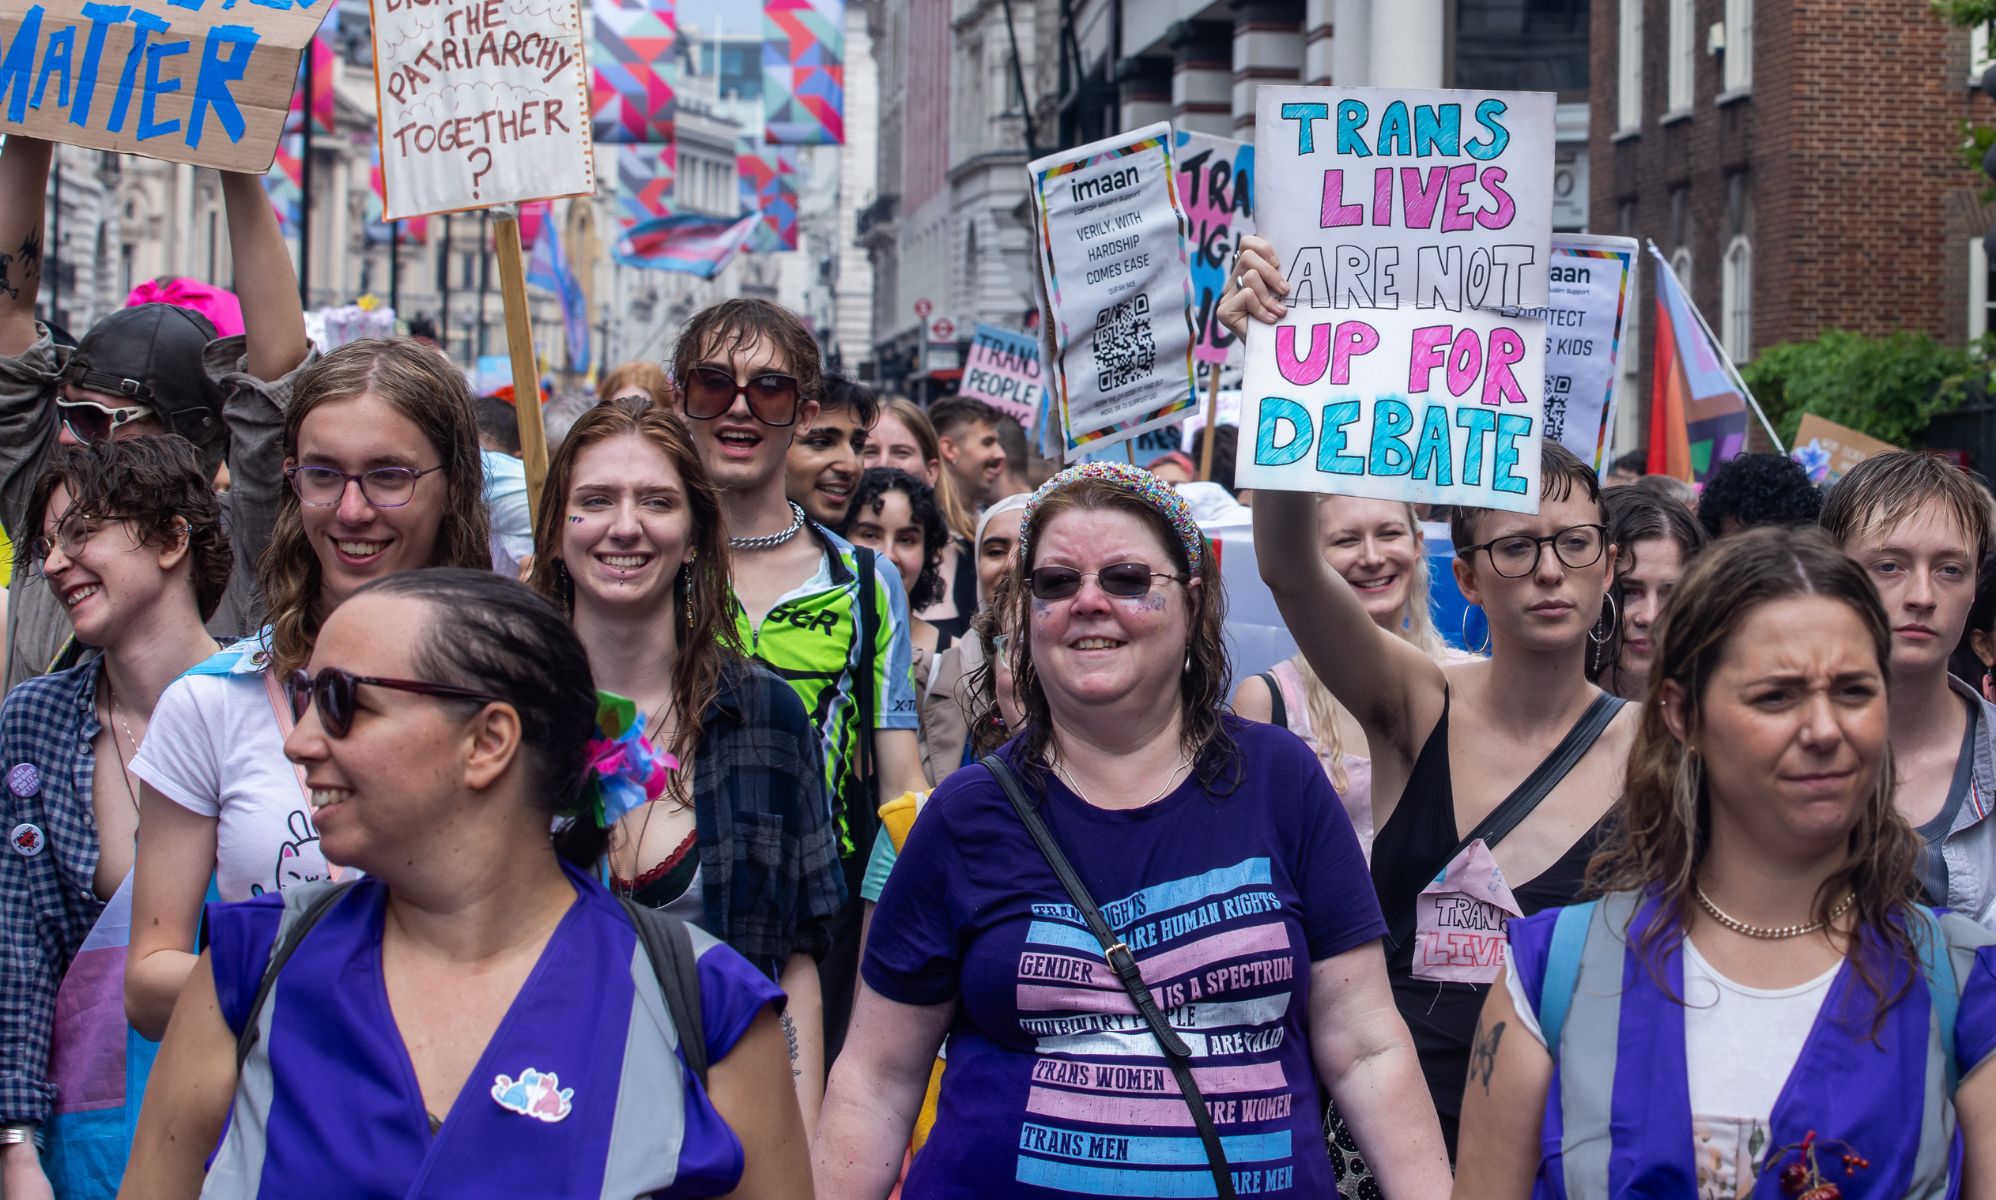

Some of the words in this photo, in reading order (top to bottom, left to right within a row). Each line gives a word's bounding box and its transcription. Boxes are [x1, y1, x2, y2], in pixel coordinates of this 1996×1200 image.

[444, 0, 507, 36] THE
[387, 31, 572, 104] PATRIARCHY
[393, 99, 570, 157] TOGETHER
[1281, 98, 1510, 160] TRANS
[467, 147, 492, 200] ?
[1071, 166, 1140, 203] imaan
[1320, 163, 1516, 233] LIVES
[1077, 222, 1115, 242] VERILY,
[1115, 211, 1142, 230] WITH
[1088, 234, 1140, 262] HARDSHIP
[1086, 262, 1122, 285] COMES
[1124, 253, 1150, 273] EASE
[1286, 245, 1399, 310] ARE
[1416, 244, 1535, 317] NOT
[1550, 266, 1590, 284] aan
[1275, 320, 1380, 386] UP
[1408, 325, 1528, 406] FOR
[1557, 338, 1593, 356] KIDS
[968, 368, 1038, 406] PEOPLE
[1254, 396, 1533, 495] DEBATE
[1128, 923, 1158, 951] ARE
[1160, 902, 1221, 942] HUMAN
[1222, 892, 1282, 920] RIGHTS
[1021, 955, 1093, 984] GENDER
[1166, 983, 1185, 1009] IS
[1190, 977, 1204, 1000] A
[1206, 956, 1294, 995] SPECTRUM
[1021, 1013, 1125, 1035] NONBINARY
[1210, 1033, 1243, 1055] ARE
[1244, 1026, 1285, 1053] VALID
[1036, 1060, 1089, 1086] TRANS
[1096, 1066, 1166, 1091] WOMEN
[1241, 1093, 1292, 1122] WOMEN
[1024, 1125, 1084, 1156] TRANS
[1088, 1136, 1129, 1160] MEN
[1265, 1165, 1294, 1192] MEN
